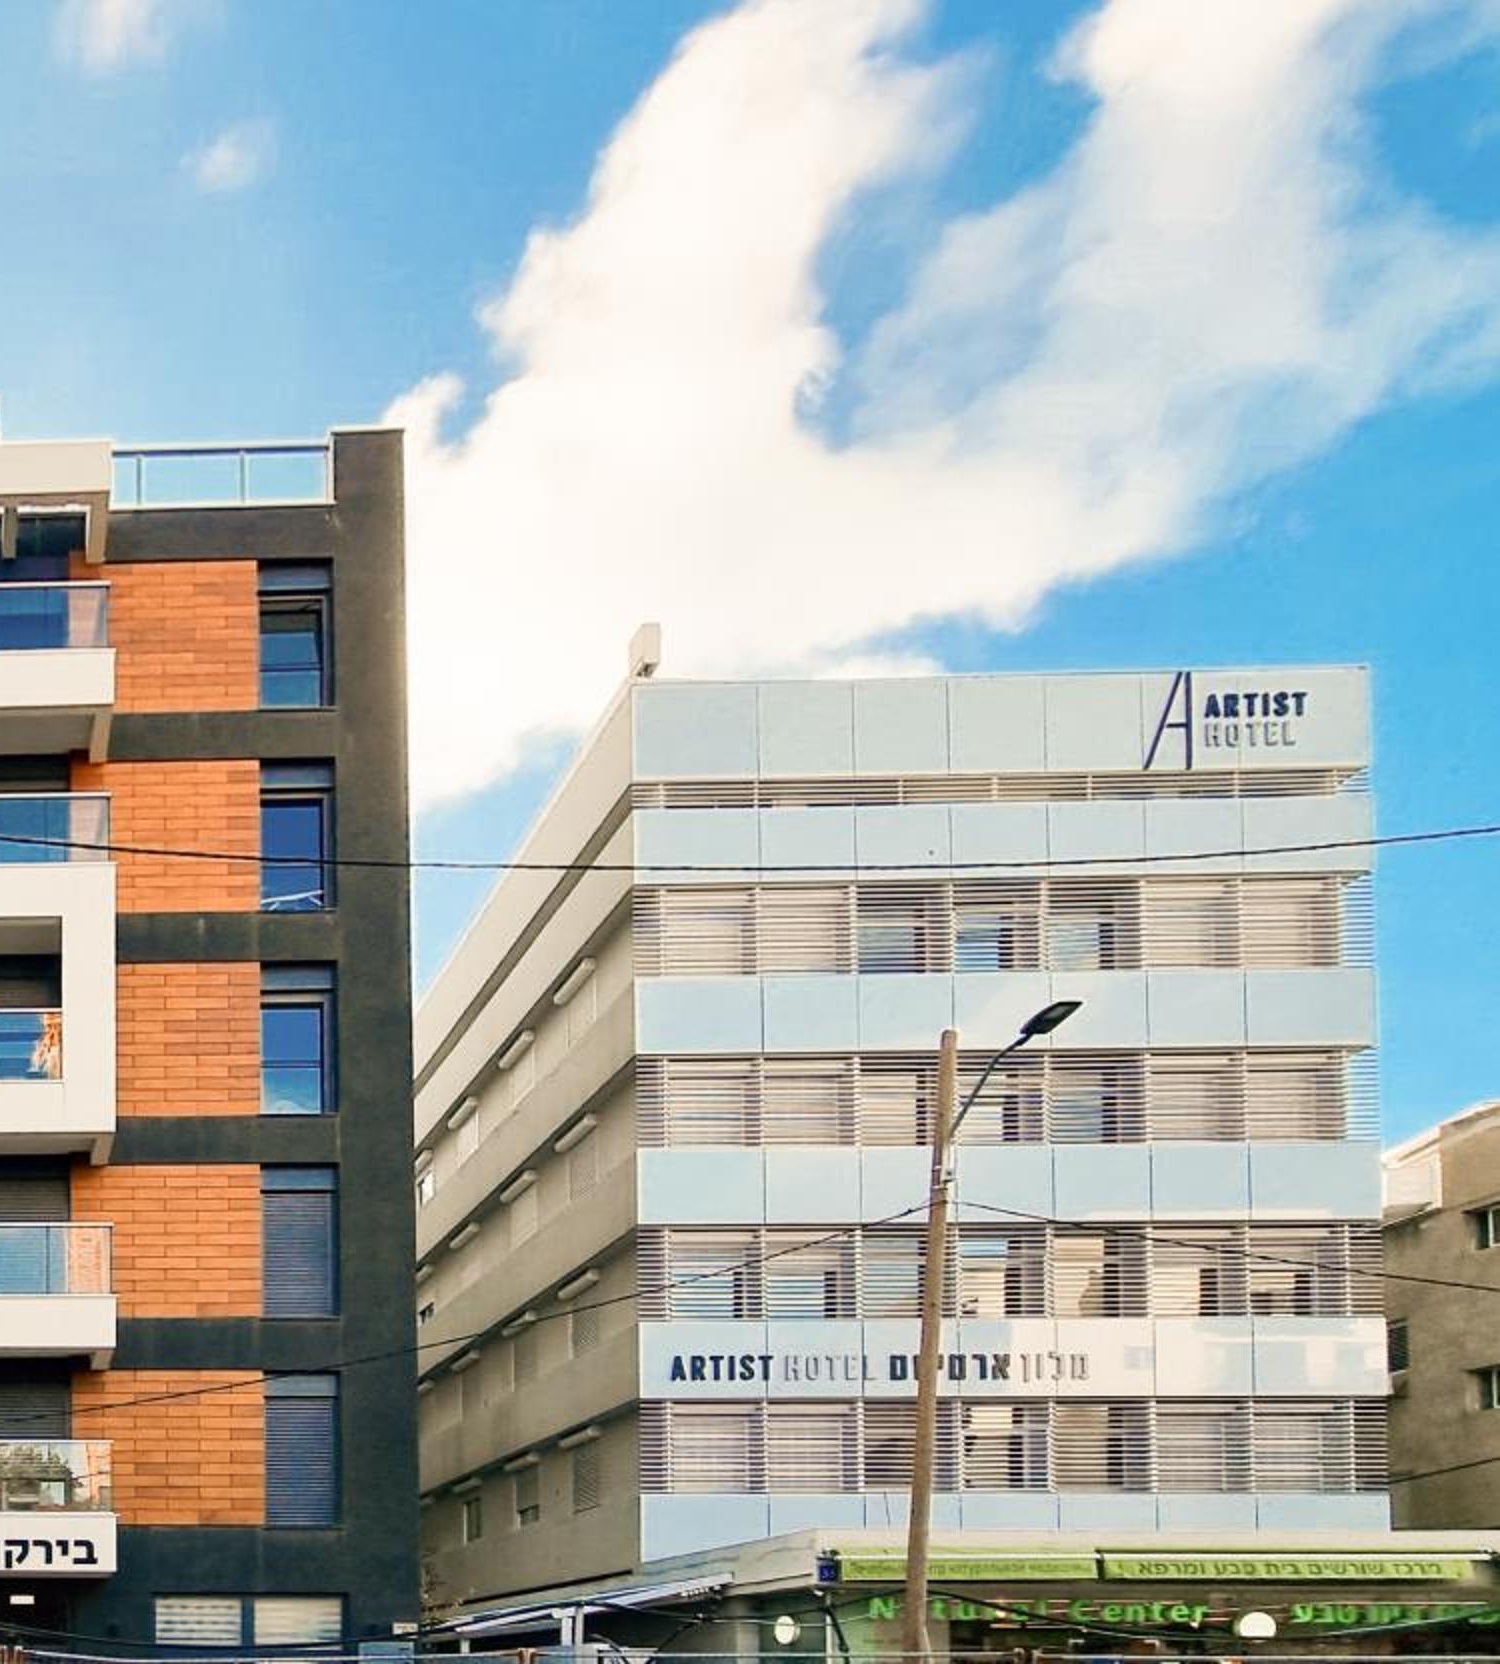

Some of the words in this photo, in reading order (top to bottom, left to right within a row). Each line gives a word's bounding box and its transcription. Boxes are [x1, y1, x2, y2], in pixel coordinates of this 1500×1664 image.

[1203, 691, 1308, 718] ARTIST
[1203, 721, 1297, 748] HOTEL
[670, 1354, 774, 1381] ARTIST
[783, 1354, 877, 1382] HOTEL
[1019, 1351, 1092, 1383] מלון
[1264, 1561, 1302, 1575] בית
[1306, 1561, 1385, 1576] שורשים
[1392, 1561, 1442, 1575] מרכז
[1069, 1602, 1210, 1624] Center
